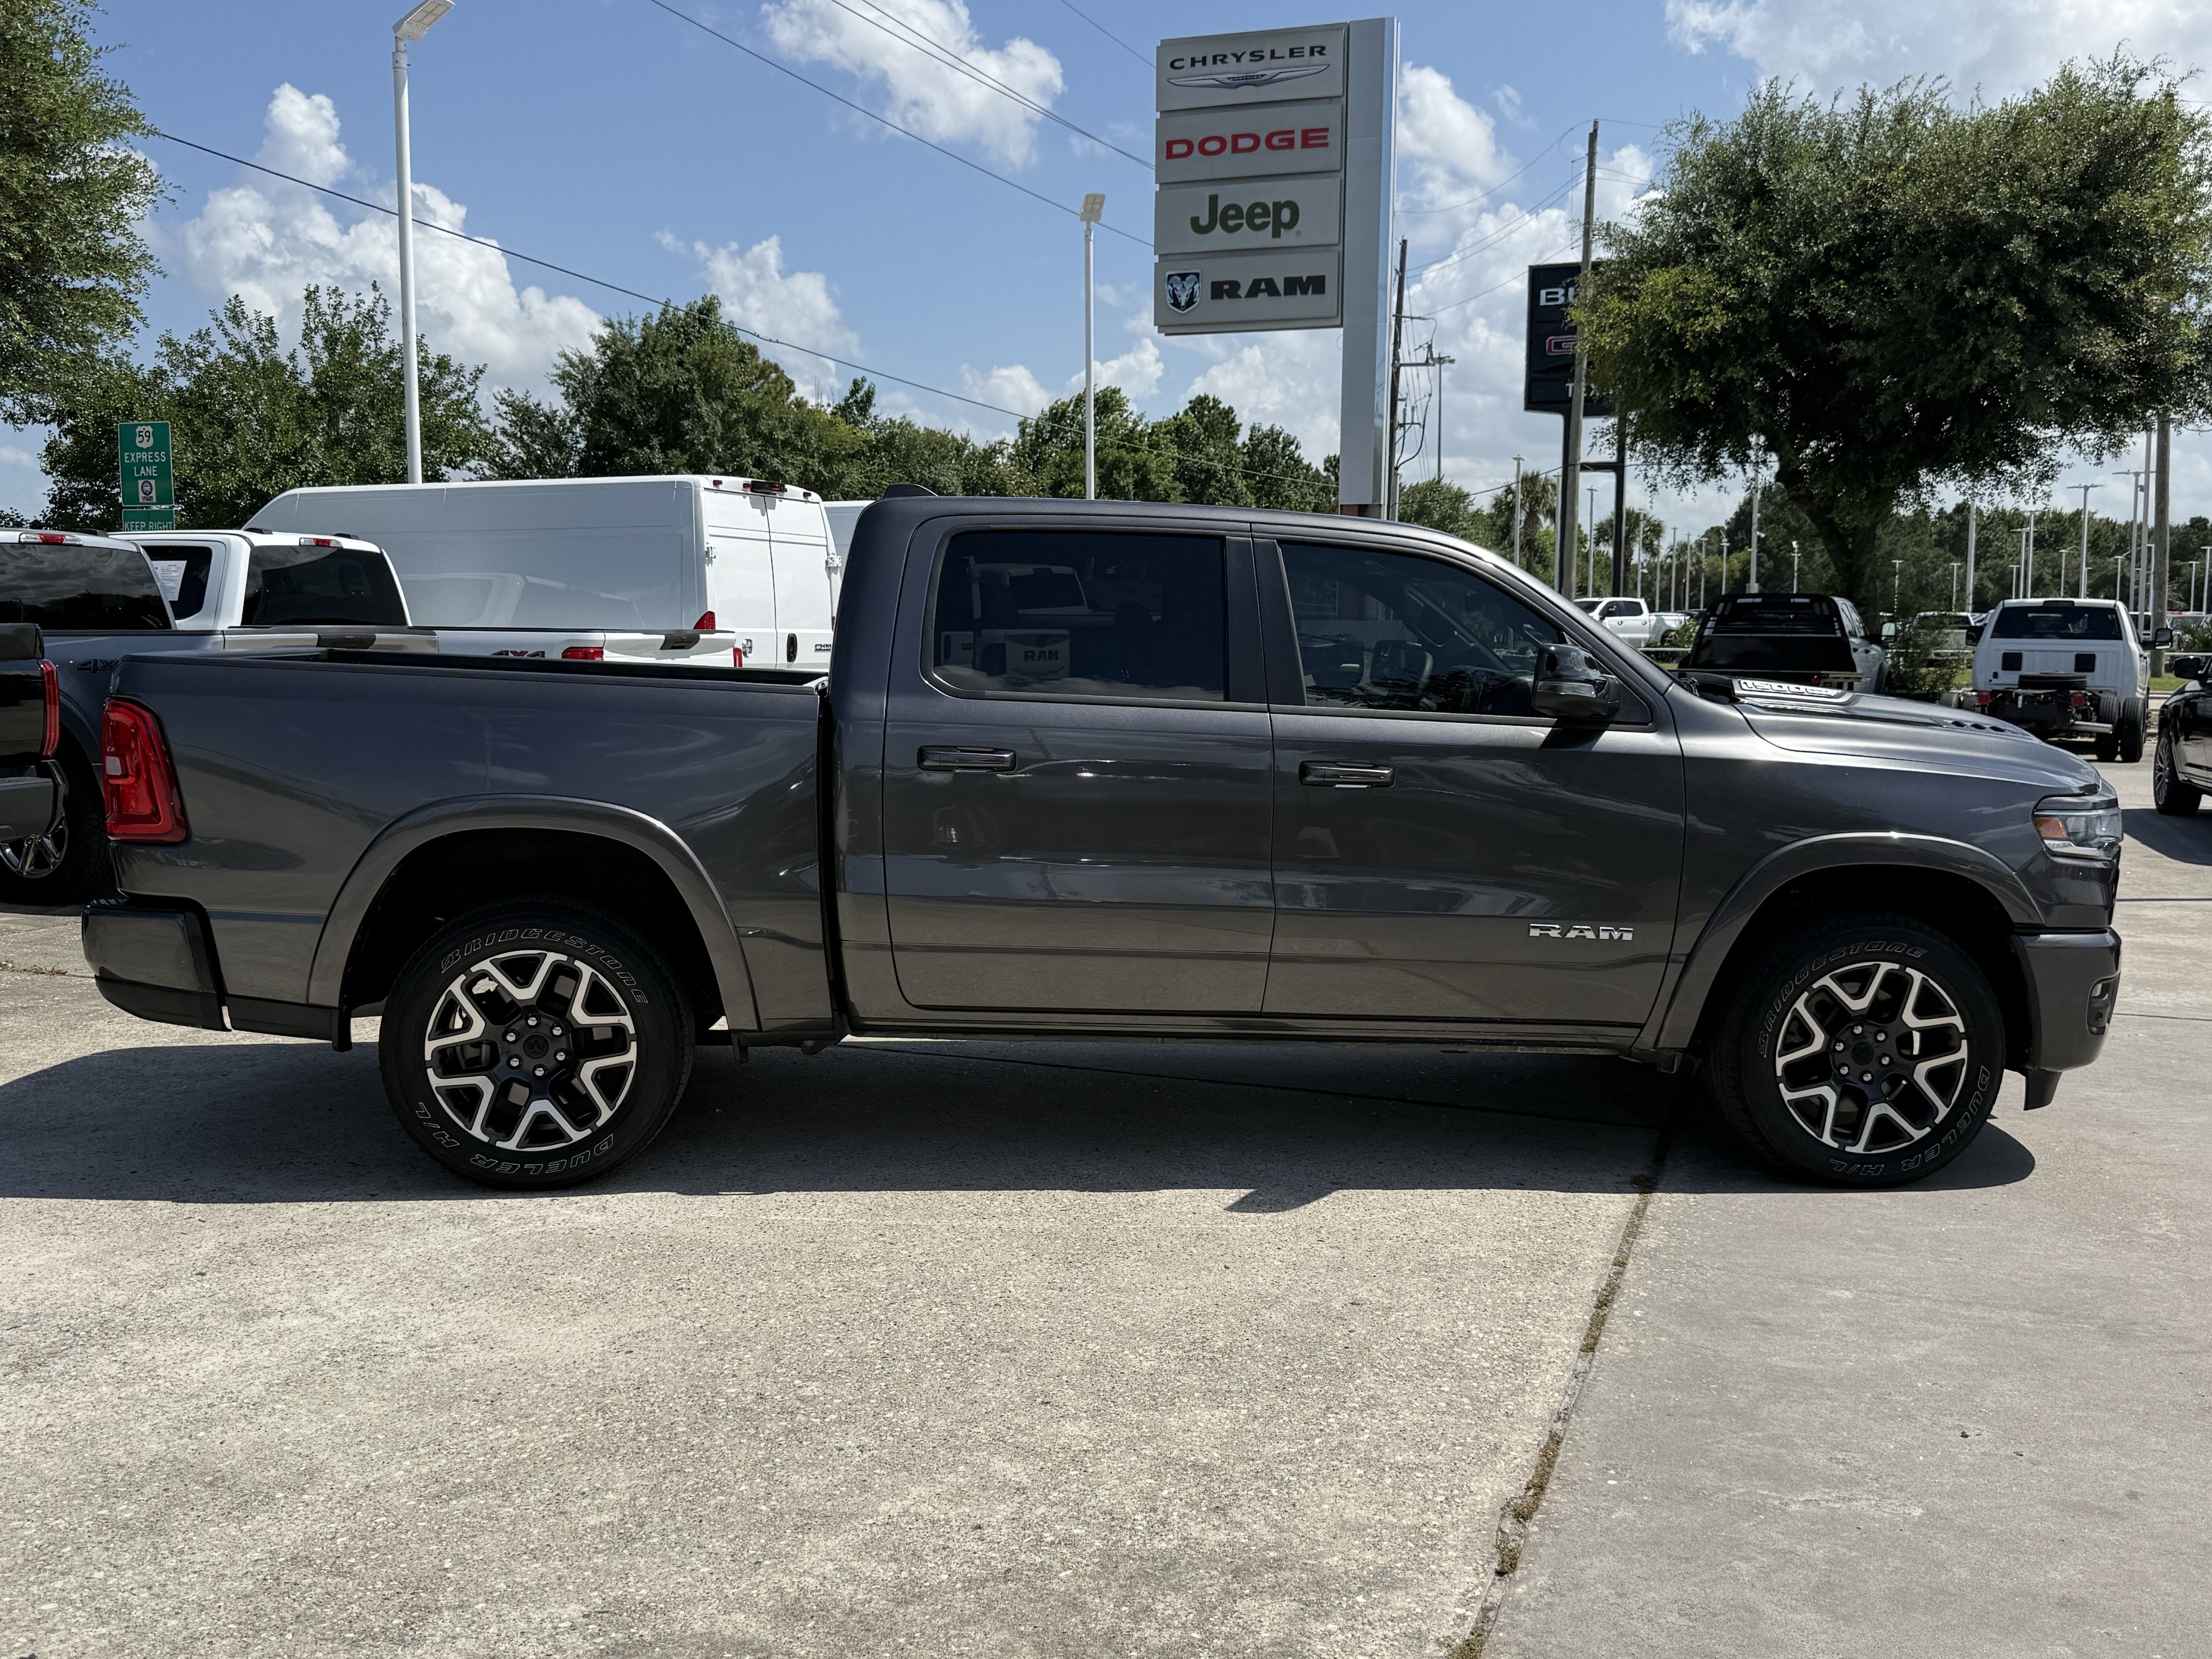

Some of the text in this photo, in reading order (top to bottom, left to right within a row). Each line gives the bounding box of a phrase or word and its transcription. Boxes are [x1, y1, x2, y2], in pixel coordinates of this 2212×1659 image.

[1169, 45, 1327, 70] CHRYSLER
[1166, 127, 1329, 160] DODGE
[1190, 194, 1300, 239] Jeep
[1211, 275, 1326, 301] RAM
[138, 430, 151, 443] 59
[124, 451, 166, 463] EXPRESS
[134, 466, 158, 476] LANE
[124, 521, 173, 531] KEEP RIGHT
[1024, 650, 1059, 661] RAM
[1529, 924, 1634, 941] RAM
[441, 928, 648, 1004] BRIDGESTONE
[1757, 941, 1927, 1058] BRIDGESTONE
[1829, 1066, 1990, 1176] DUELER H/L
[415, 1102, 614, 1175] DUELER H/L
